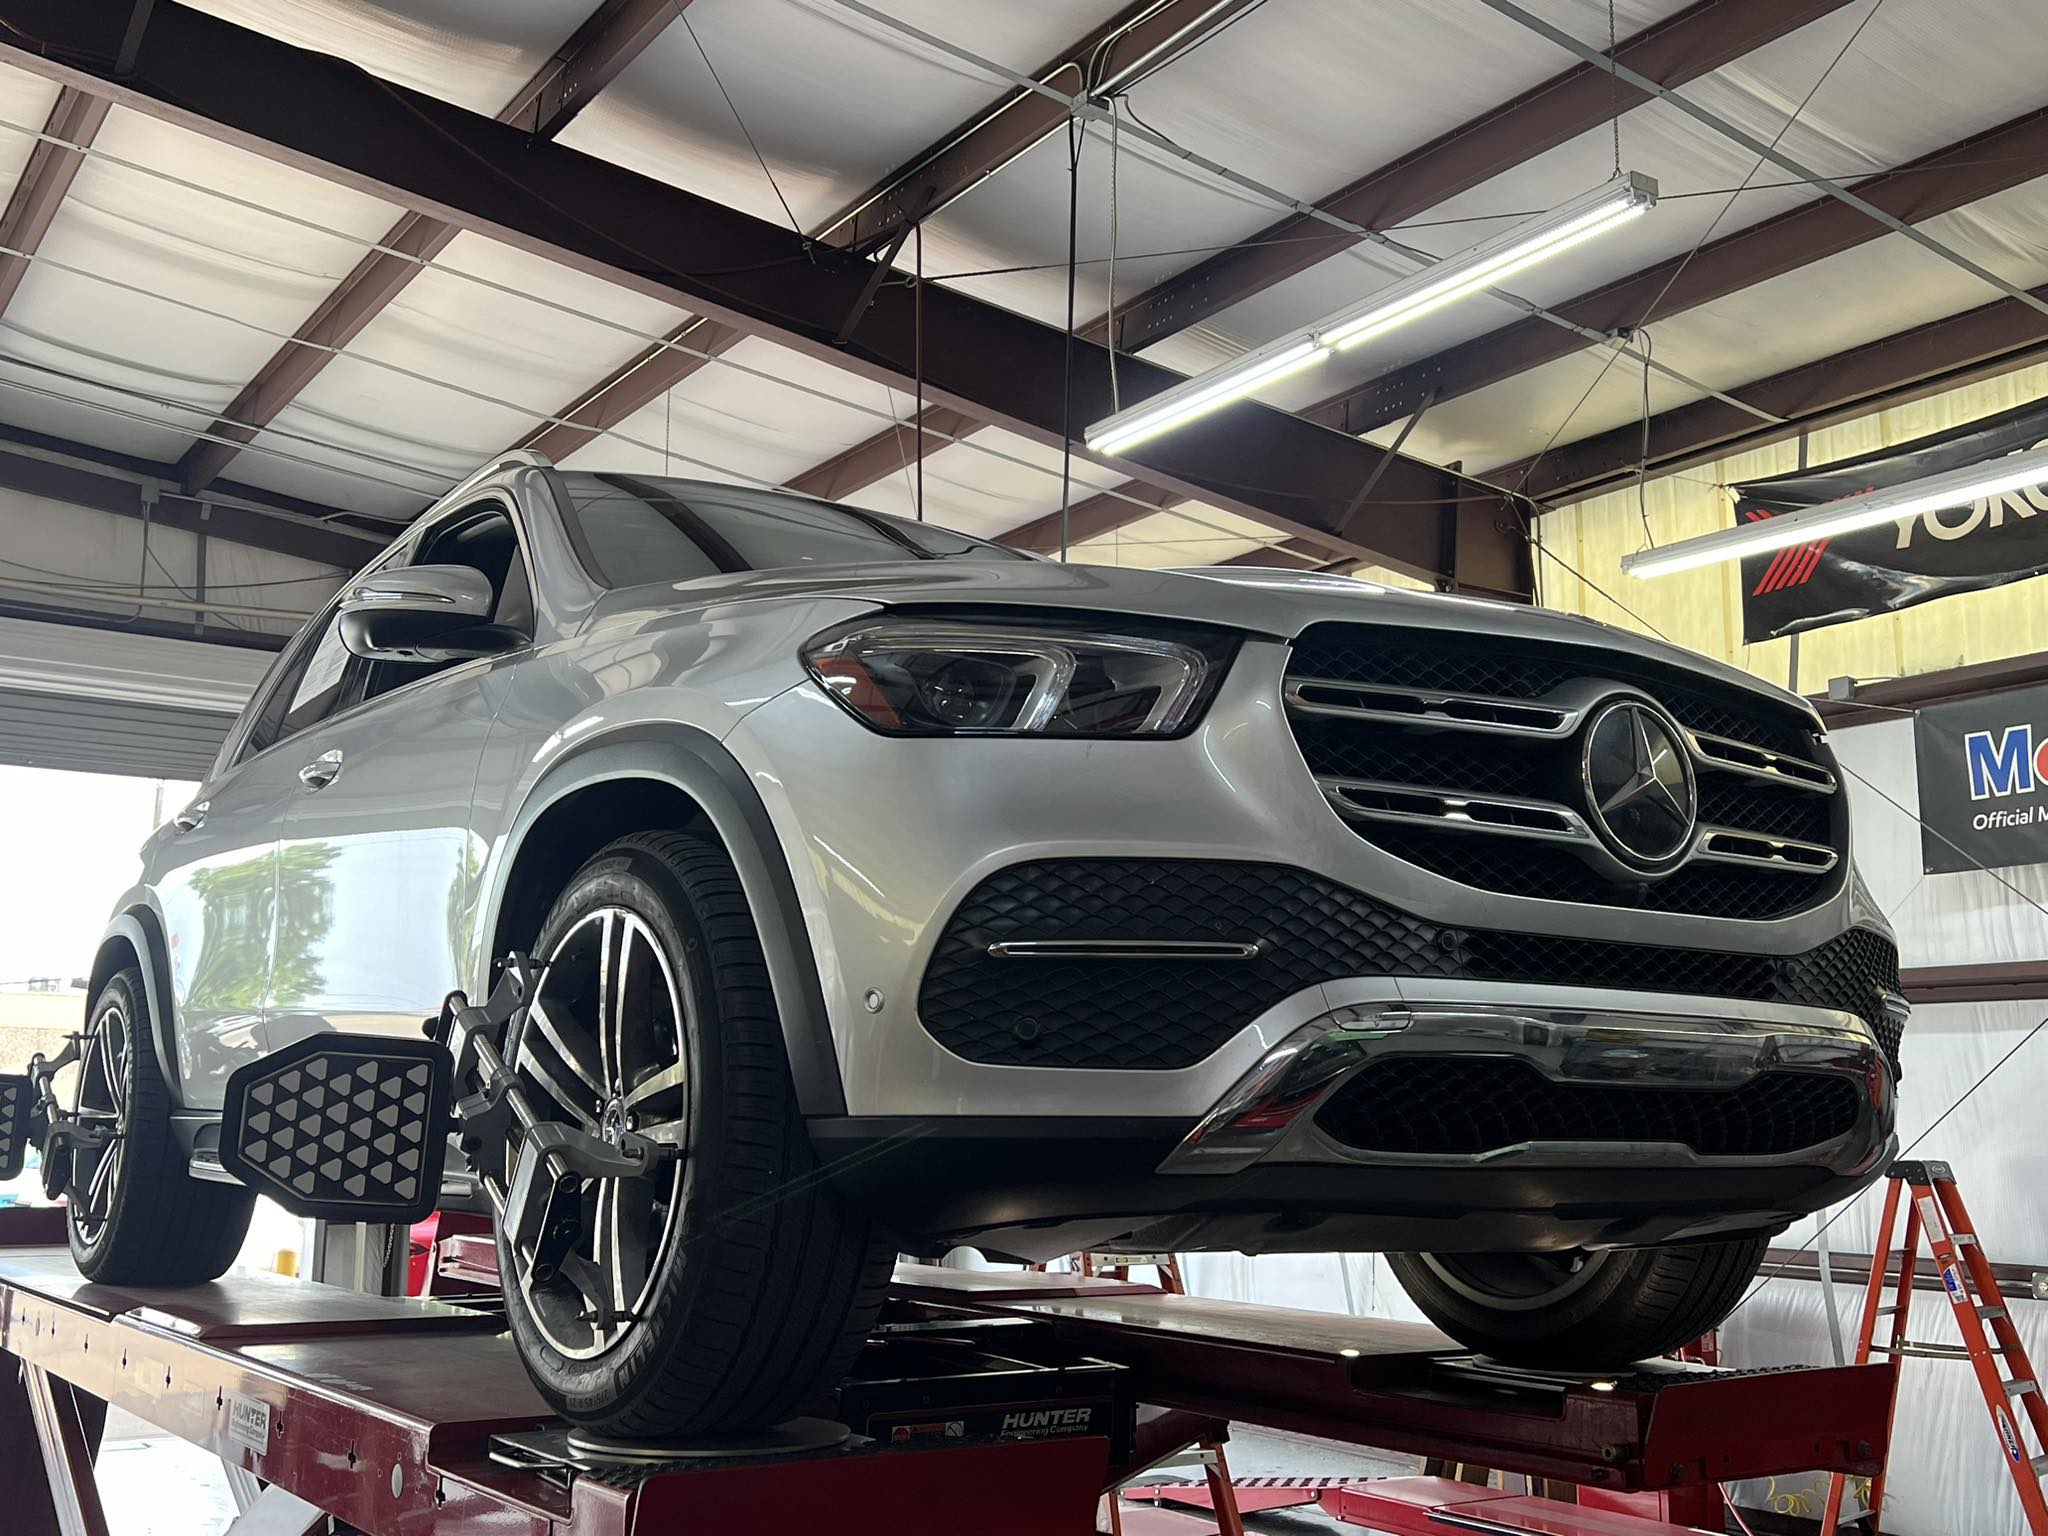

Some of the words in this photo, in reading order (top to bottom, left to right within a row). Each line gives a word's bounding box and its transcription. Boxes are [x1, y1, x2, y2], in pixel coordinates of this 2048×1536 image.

[1964, 724, 2048, 800] M
[1973, 806, 2034, 830] Official
[616, 1248, 688, 1391] MICHELIN
[233, 1402, 266, 1430] HUNTER
[1003, 1408, 1091, 1428] HUNTER
[1049, 1424, 1089, 1436] Company
